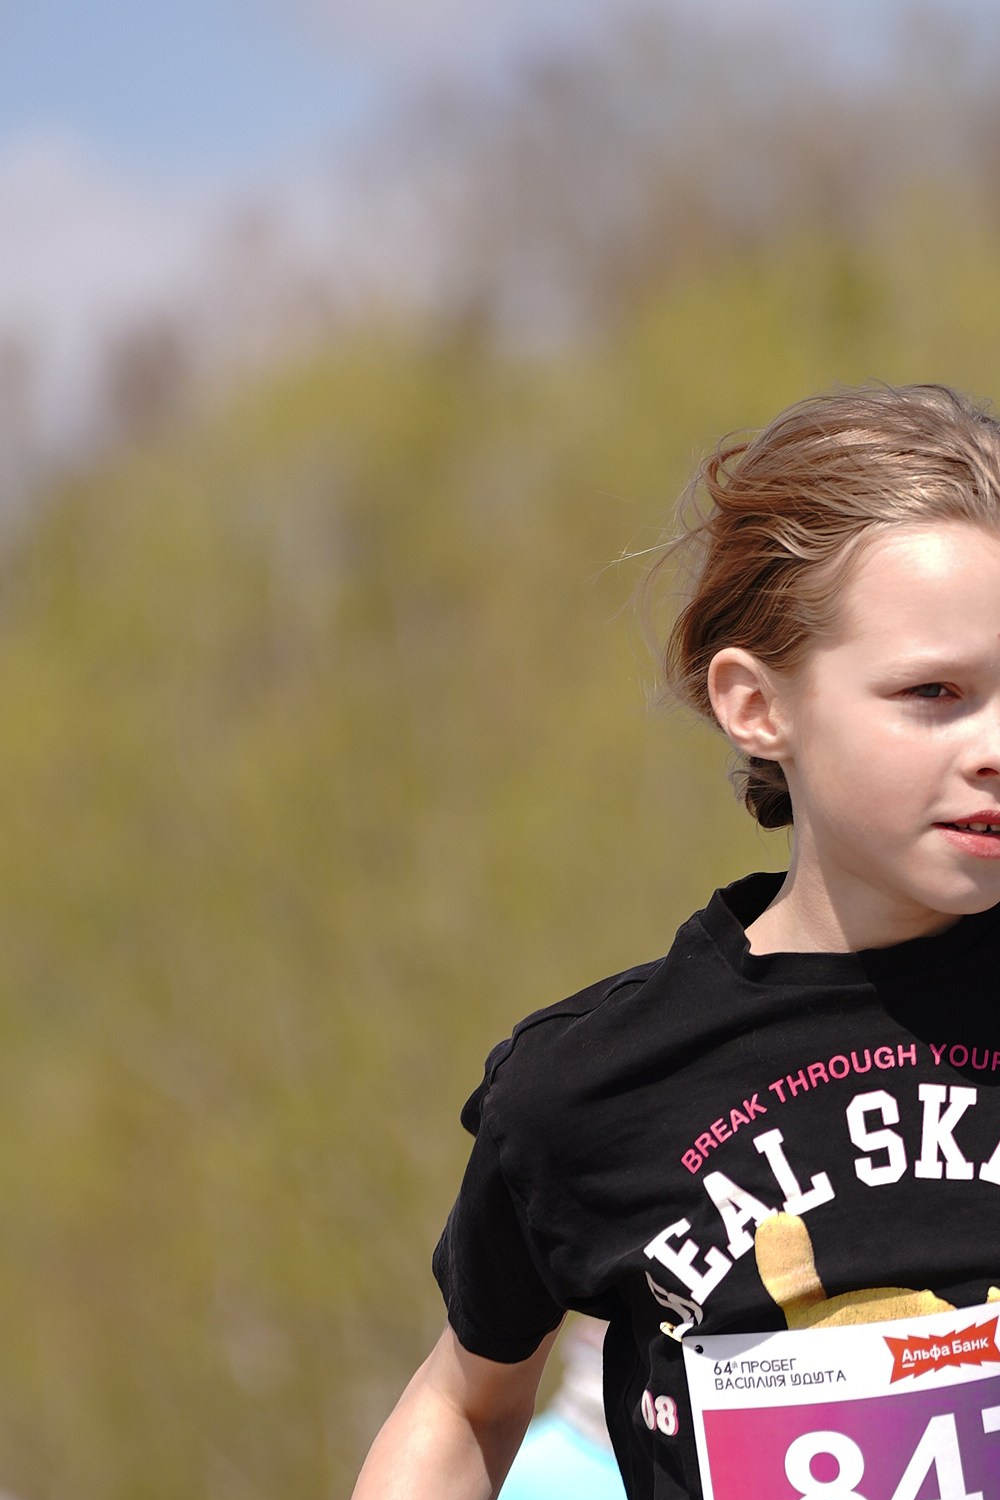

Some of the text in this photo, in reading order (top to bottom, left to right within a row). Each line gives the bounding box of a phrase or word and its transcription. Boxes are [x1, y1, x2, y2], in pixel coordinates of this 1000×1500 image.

[681, 1092, 767, 1174] BREAK
[769, 1043, 917, 1103] THROUGH
[902, 1337, 989, 1364] Альфа Банк
[740, 1358, 797, 1374] ПРОБЕГ
[714, 1374, 786, 1391] ВАСИЛИЯ
